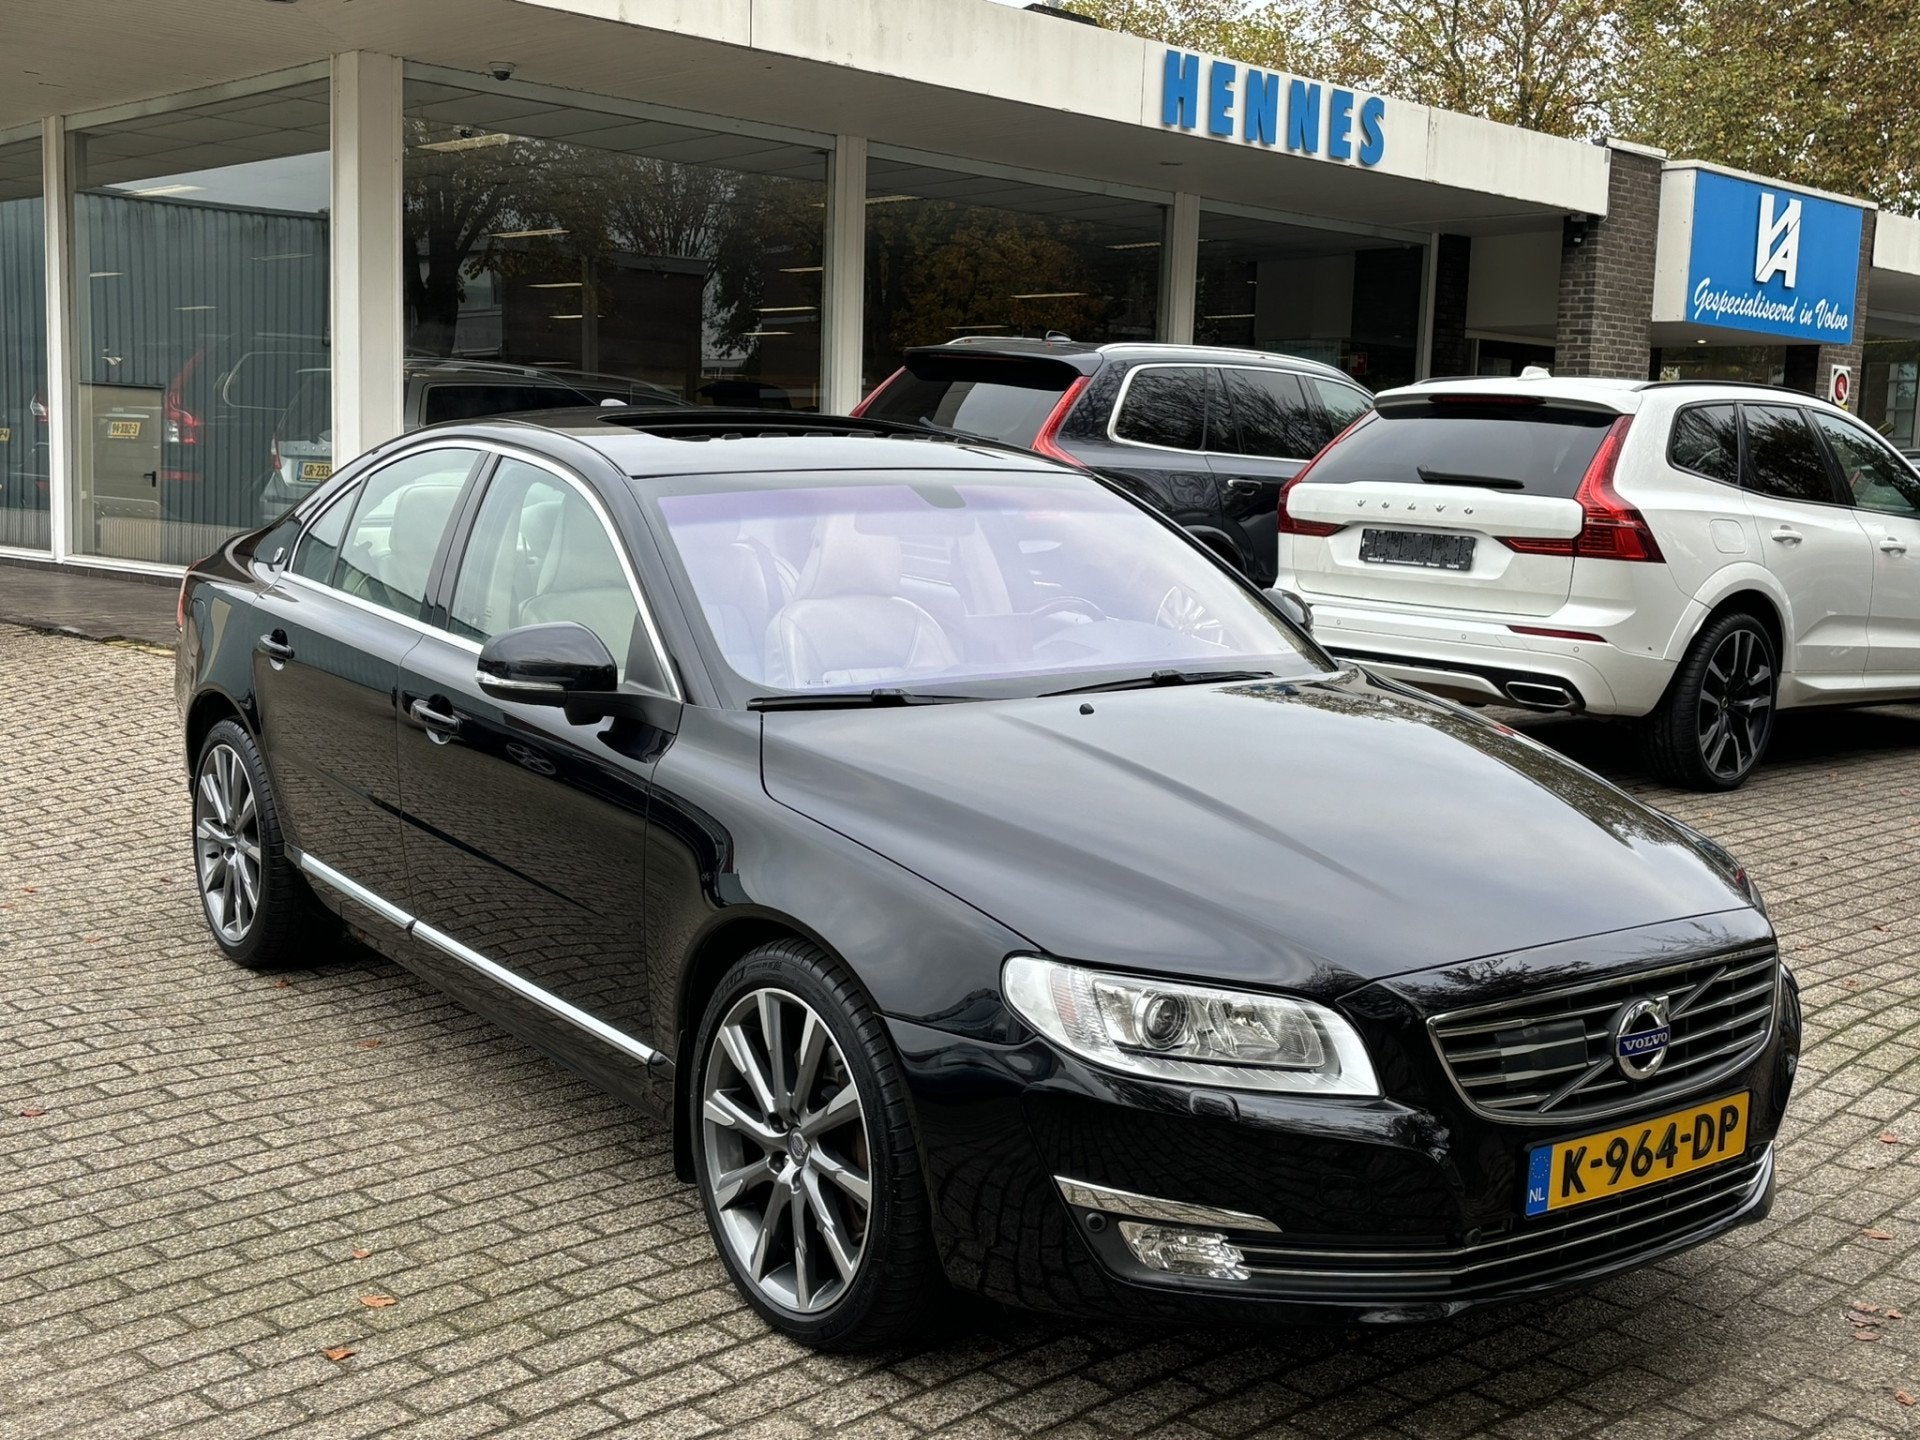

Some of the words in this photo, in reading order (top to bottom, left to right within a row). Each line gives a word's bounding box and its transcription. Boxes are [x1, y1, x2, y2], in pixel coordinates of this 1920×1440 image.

[1162, 49, 1385, 166] HENNES
[1693, 277, 1799, 324] Gespecialiseerd
[1799, 302, 1813, 326] in
[1815, 298, 1848, 331] Volvo
[303, 464, 332, 477] GR-233-
[1623, 1032, 1668, 1051] VOLVO
[1561, 1104, 1740, 1198] K-964-DP
[1529, 1187, 1546, 1204] NL
